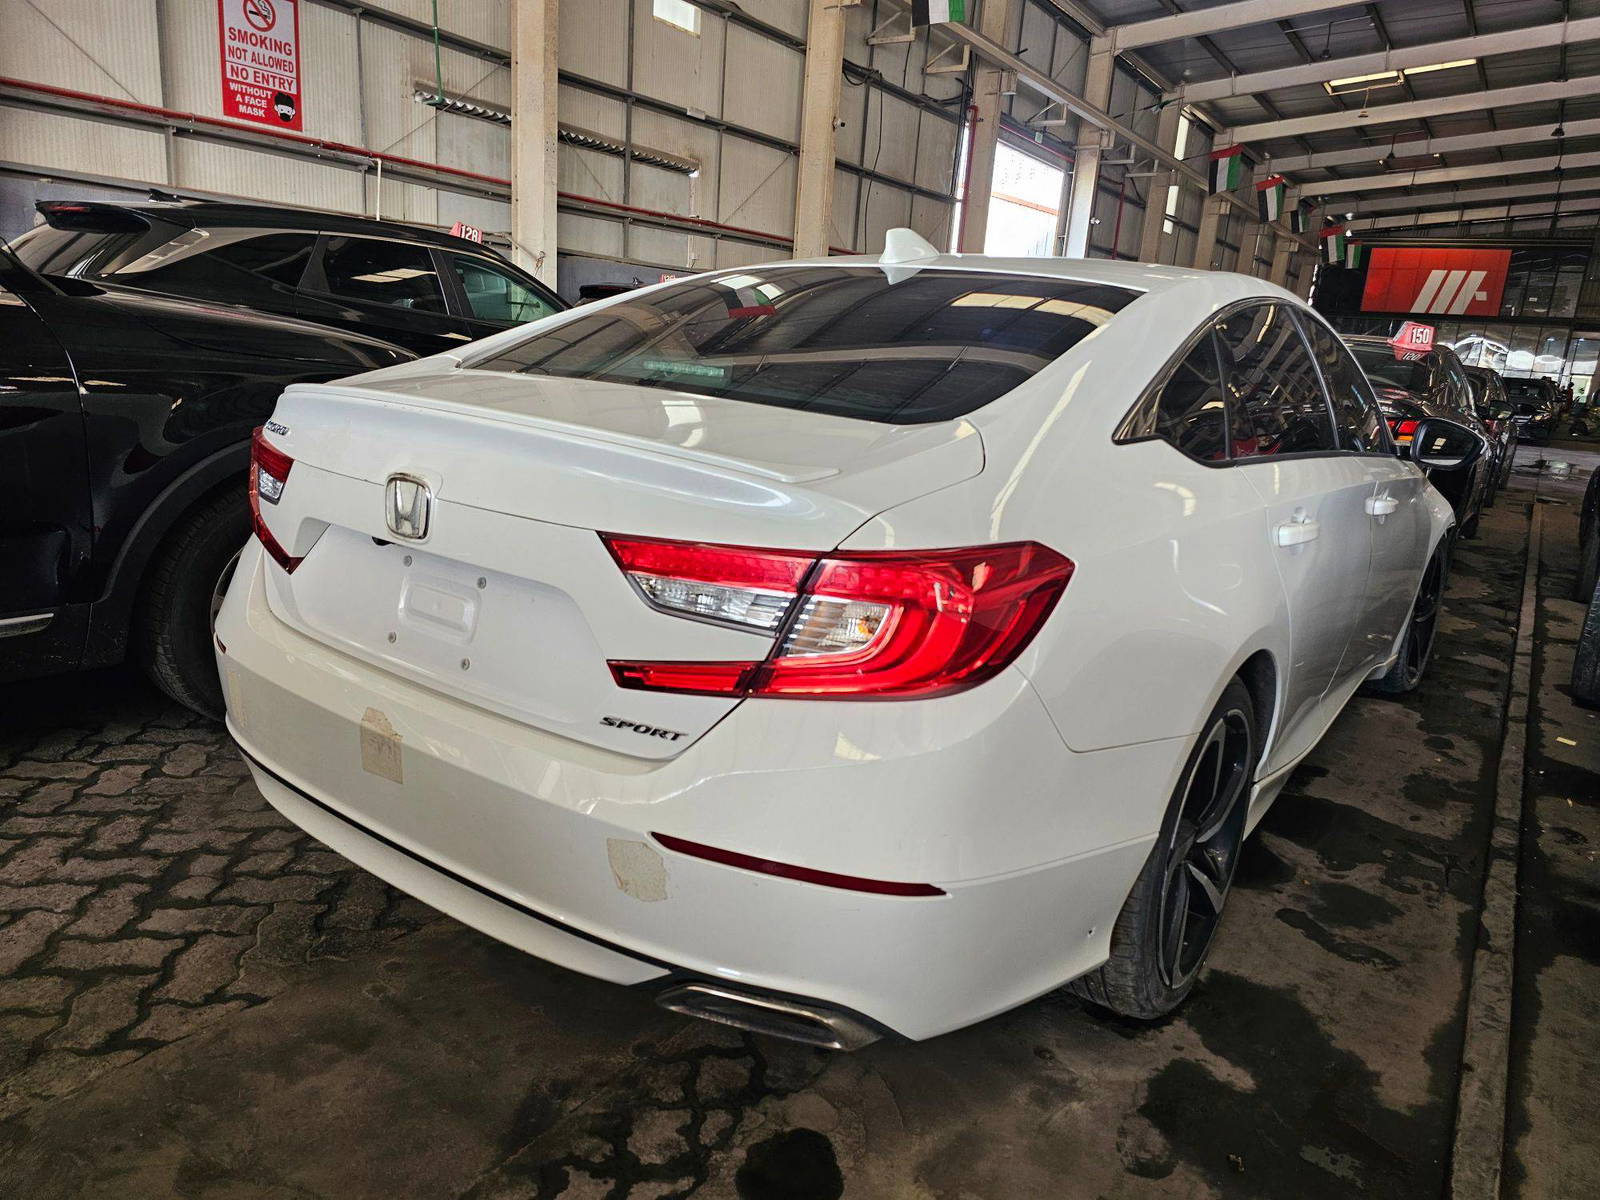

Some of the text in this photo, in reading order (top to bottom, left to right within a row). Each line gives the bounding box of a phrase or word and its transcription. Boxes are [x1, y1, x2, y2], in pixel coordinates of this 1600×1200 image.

[228, 26, 292, 56] SMOKING
[228, 45, 294, 73] NOT ALLOWED
[230, 65, 294, 92] NO ENTRY
[229, 82, 272, 99] WITHOUT
[236, 94, 268, 108] A FACE
[239, 104, 265, 117] MASK
[1411, 327, 1430, 344] 150
[599, 716, 689, 741] SPORT
